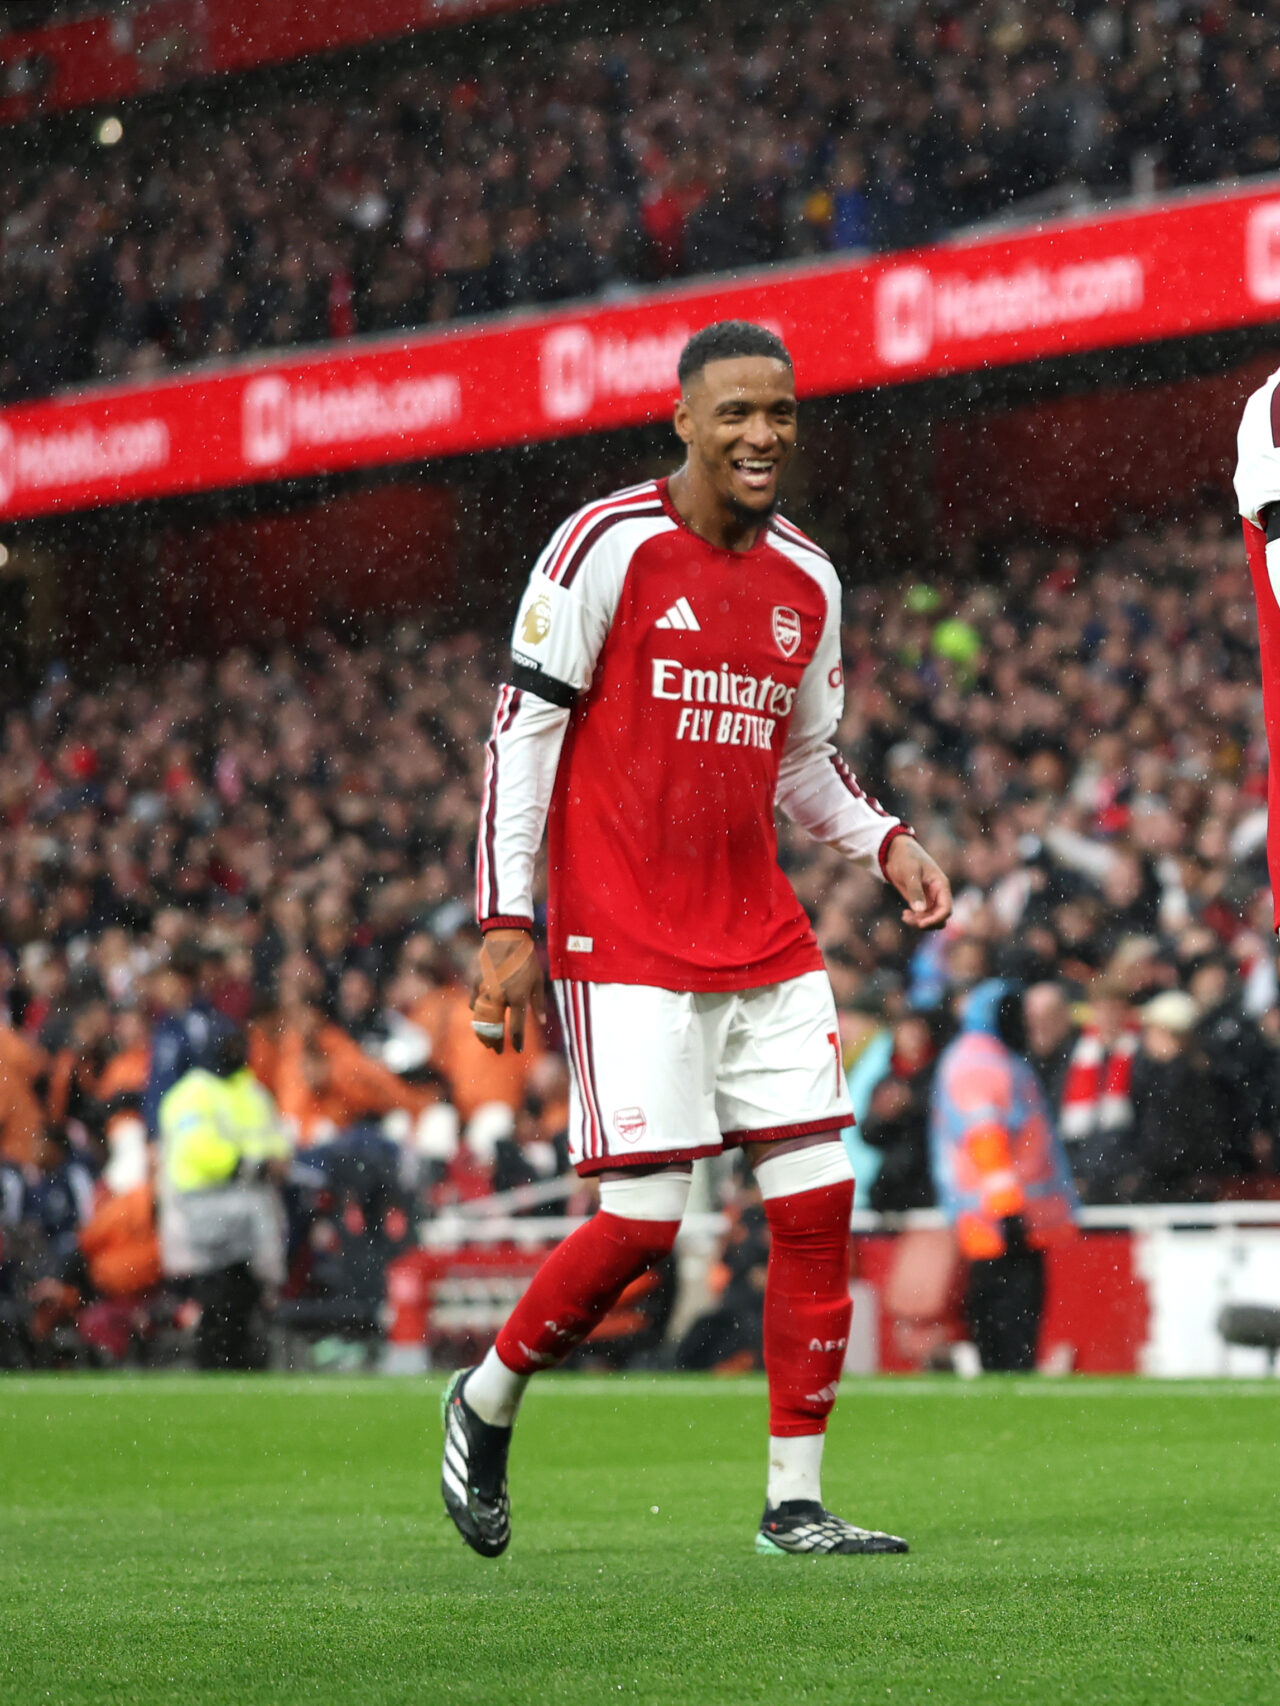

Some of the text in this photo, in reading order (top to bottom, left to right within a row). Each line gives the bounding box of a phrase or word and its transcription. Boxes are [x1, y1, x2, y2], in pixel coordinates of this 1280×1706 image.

[651, 658, 797, 717] Emirates
[676, 707, 776, 751] FLY BETTER
